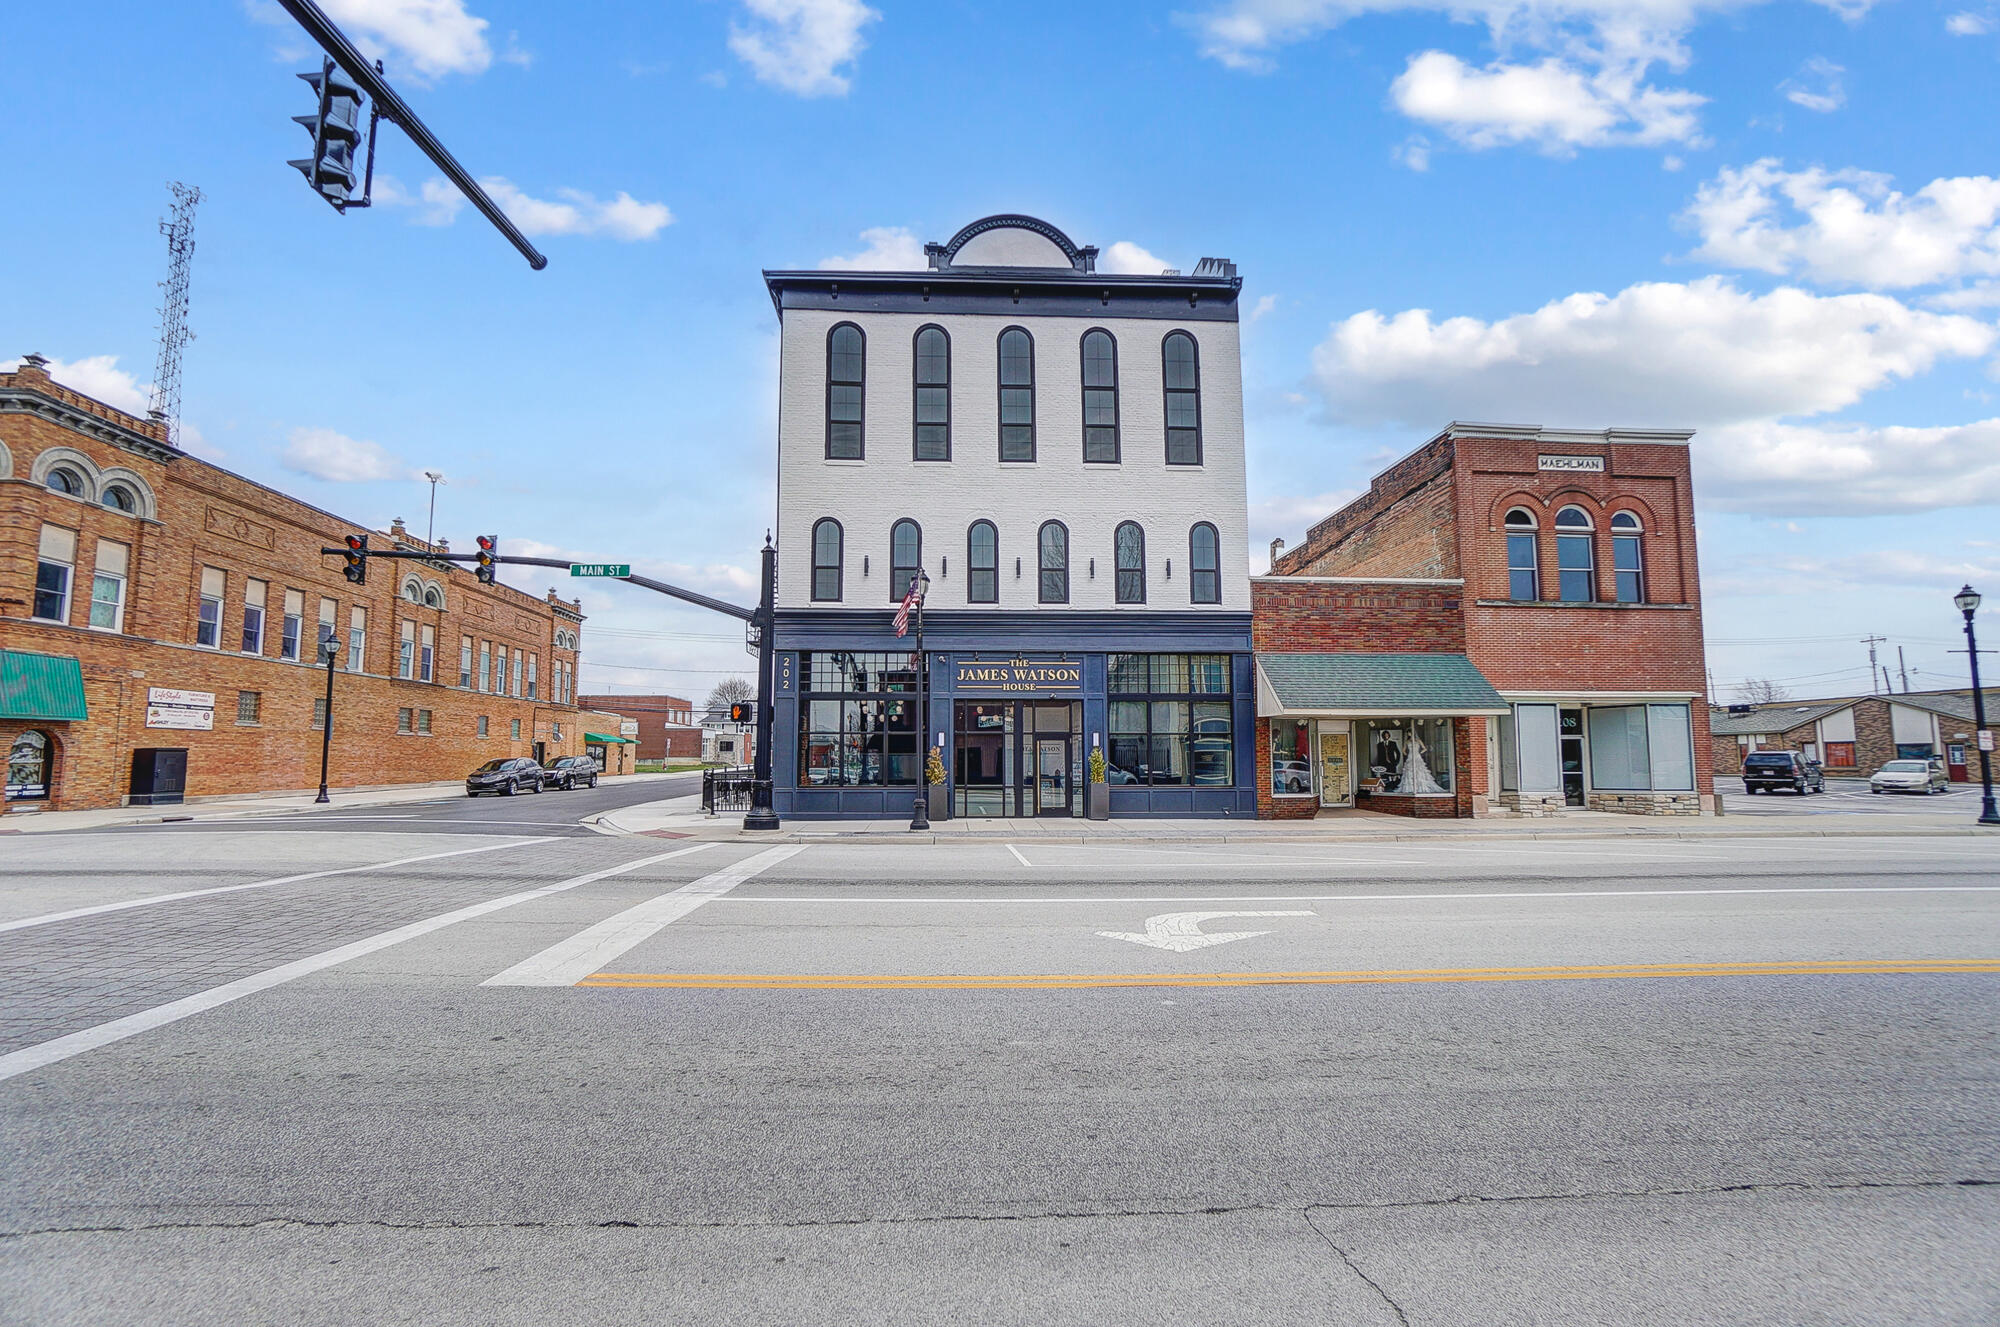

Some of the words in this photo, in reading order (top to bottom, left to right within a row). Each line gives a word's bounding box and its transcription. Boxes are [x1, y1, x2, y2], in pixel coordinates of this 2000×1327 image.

[1540, 459, 1599, 469] MAEHLMAN
[579, 565, 604, 576] MAIN
[608, 565, 621, 576] ST
[1008, 659, 1030, 667] THE
[957, 668, 1009, 681] JAMES
[1013, 668, 1080, 681] WATSON
[1002, 683, 1037, 691] HOUSE
[1560, 717, 1577, 727] 08
